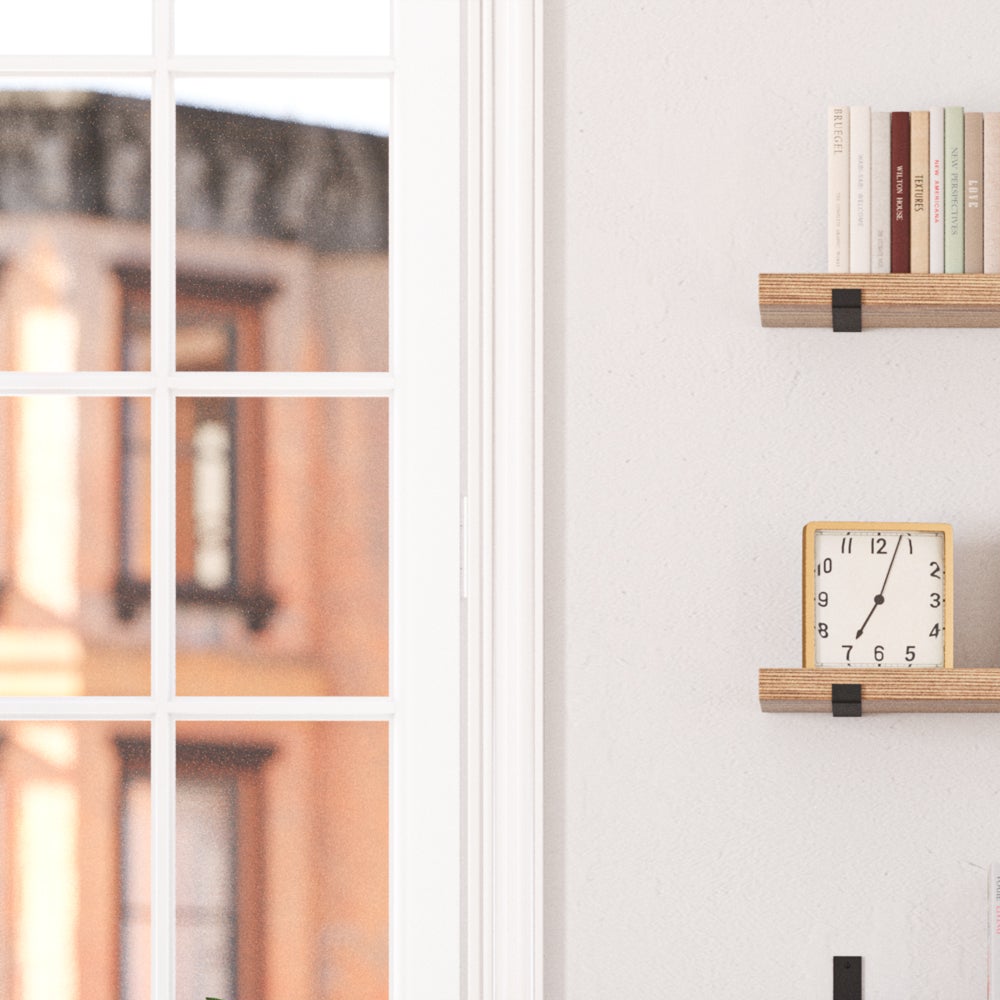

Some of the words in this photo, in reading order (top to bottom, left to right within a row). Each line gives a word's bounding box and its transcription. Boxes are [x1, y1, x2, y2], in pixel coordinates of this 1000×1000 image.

[833, 108, 843, 154] BRUEGEL
[914, 175, 924, 212] TEXTURES
[968, 179, 978, 208] LOVE
[841, 538, 852, 554] 11
[870, 538, 888, 554] 12
[907, 538, 913, 554] 1
[816, 557, 832, 576] 10
[929, 562, 941, 579] 2
[818, 591, 829, 607] 9
[929, 592, 941, 608] 3
[818, 622, 829, 639] 8
[929, 622, 941, 639] 4
[841, 645, 853, 661] 7
[873, 645, 885, 661] 6
[904, 645, 916, 661] 5
